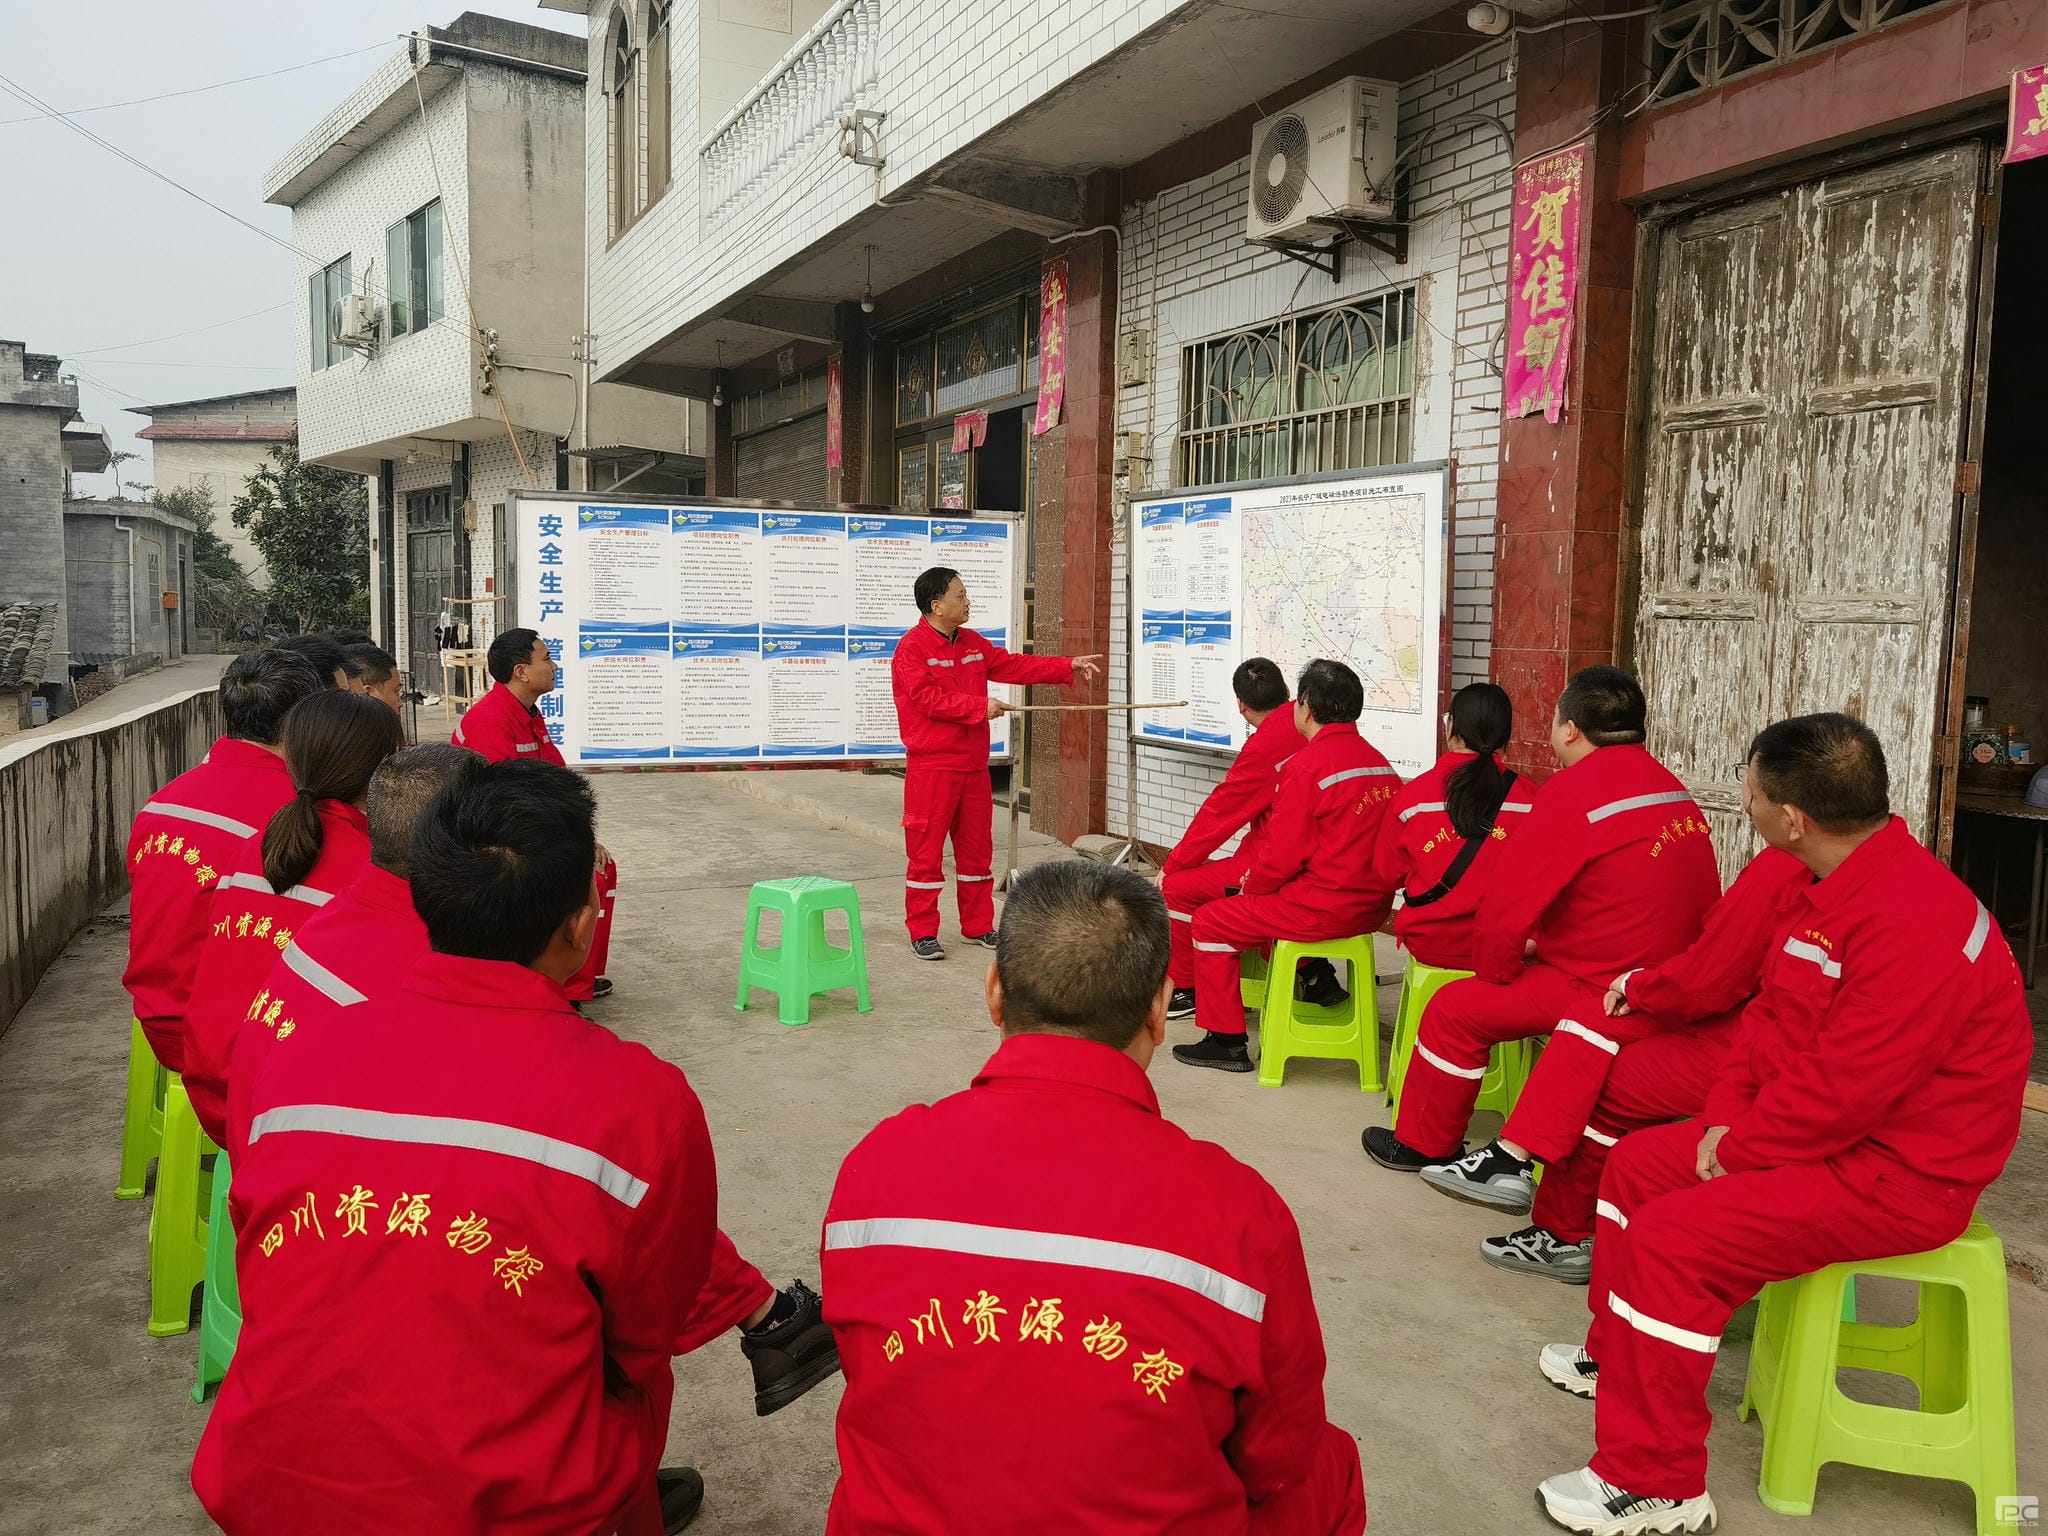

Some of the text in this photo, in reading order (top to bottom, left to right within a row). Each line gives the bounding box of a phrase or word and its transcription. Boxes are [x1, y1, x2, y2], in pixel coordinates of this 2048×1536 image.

[1317, 130, 1336, 144] Leader
[1355, 786, 1399, 815] 四川资源
[135, 831, 218, 886] 四川资源物探
[258, 1184, 544, 1297] 四川资源物探
[882, 1289, 1185, 1404] 四川资源物探
